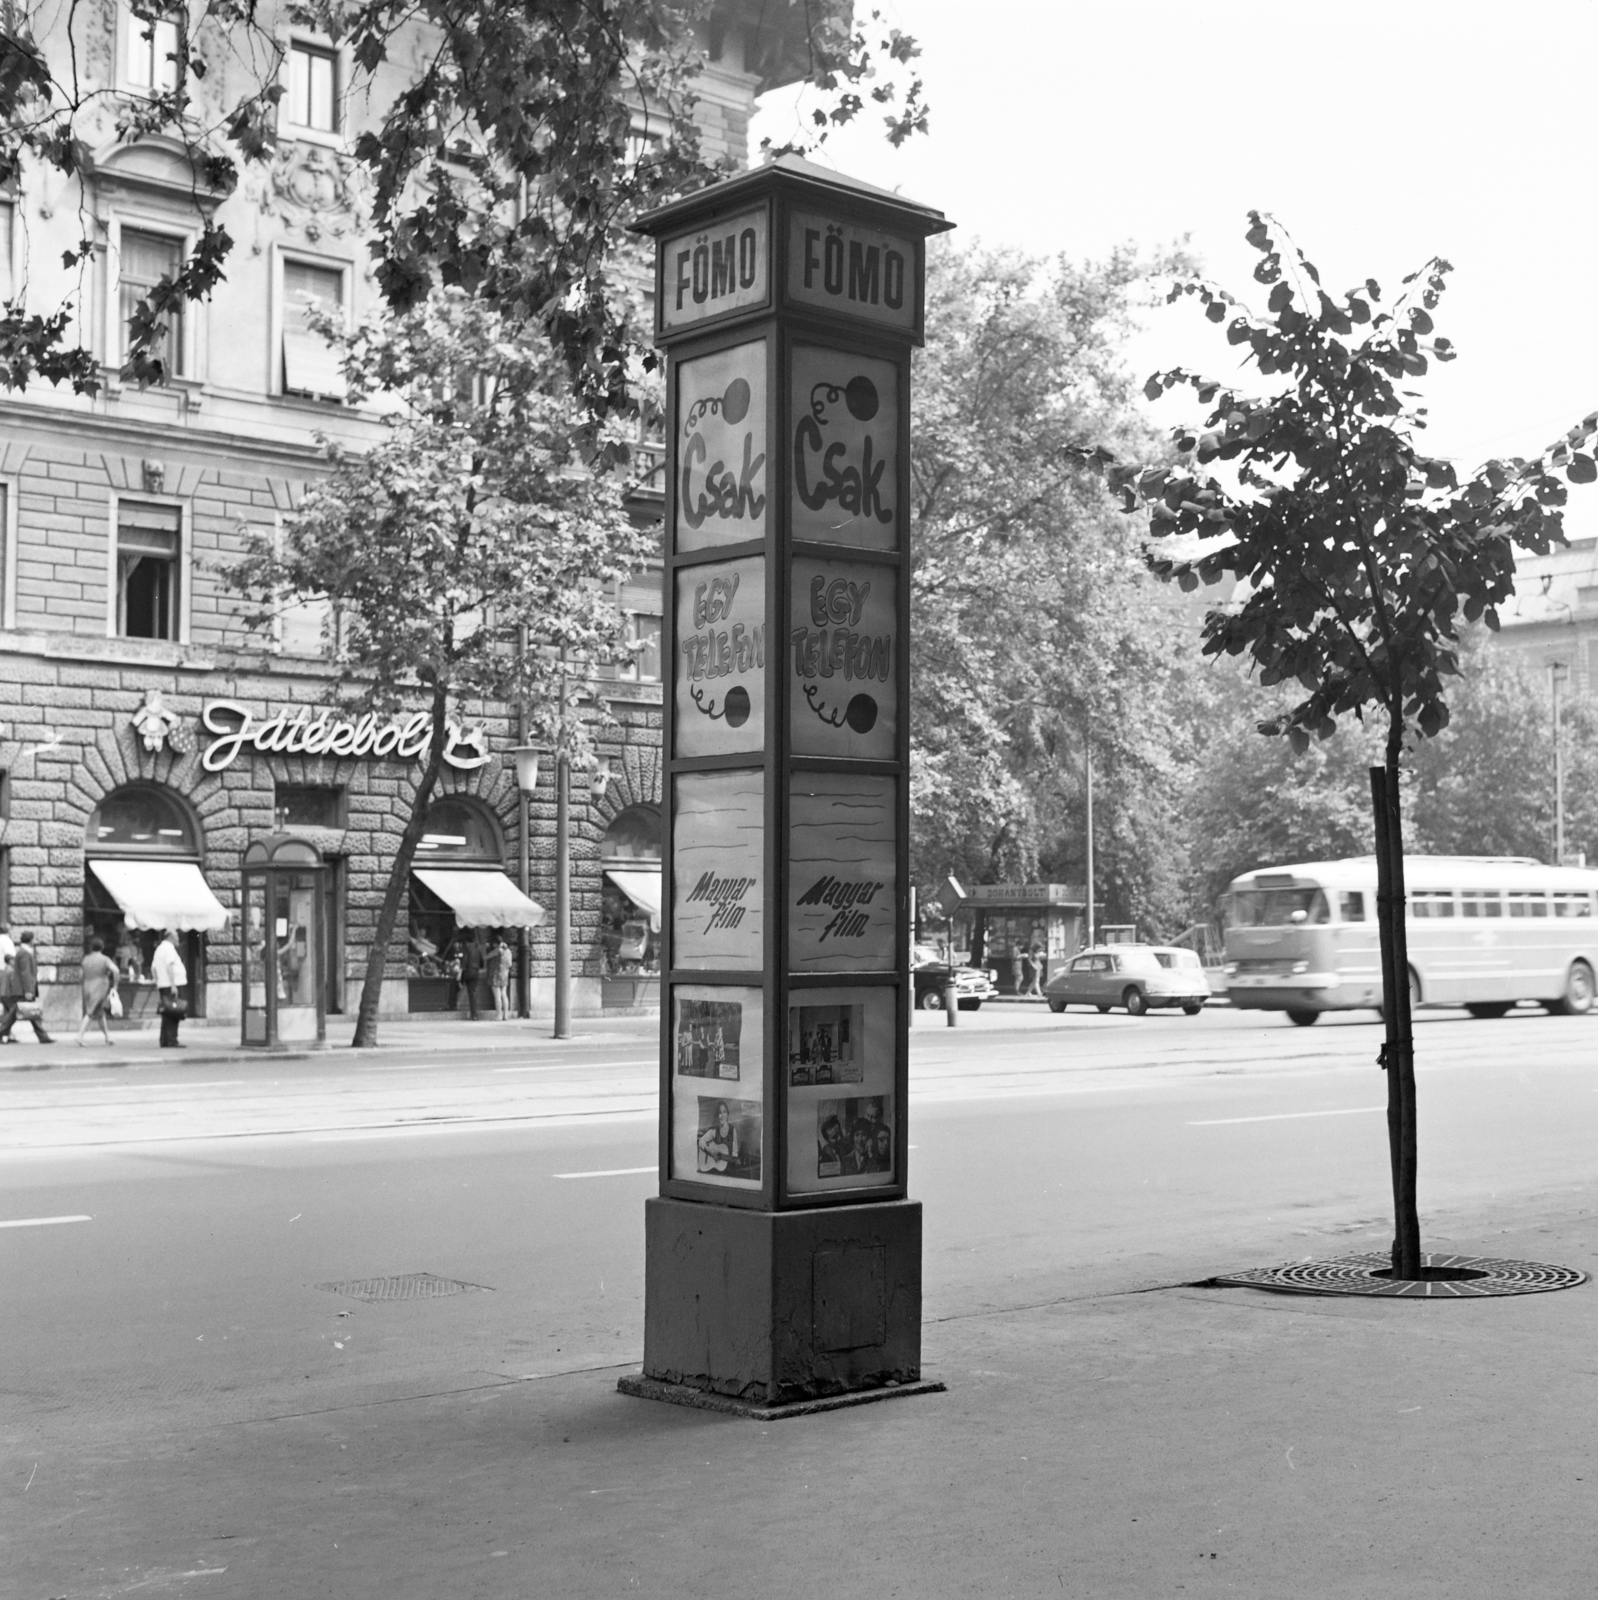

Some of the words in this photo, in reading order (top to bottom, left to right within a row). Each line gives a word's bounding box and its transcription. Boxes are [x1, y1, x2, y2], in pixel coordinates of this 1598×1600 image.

[676, 227, 756, 311] FÖMO
[804, 223, 904, 310] FÖMO
[682, 431, 766, 530] Csak
[794, 414, 893, 525] Csak
[693, 572, 740, 630] EGY
[810, 575, 871, 627] EGY
[683, 622, 765, 682] TELEFON
[791, 626, 891, 683] TELEFON
[686, 871, 756, 907] Magyar
[796, 875, 884, 911] Magyar
